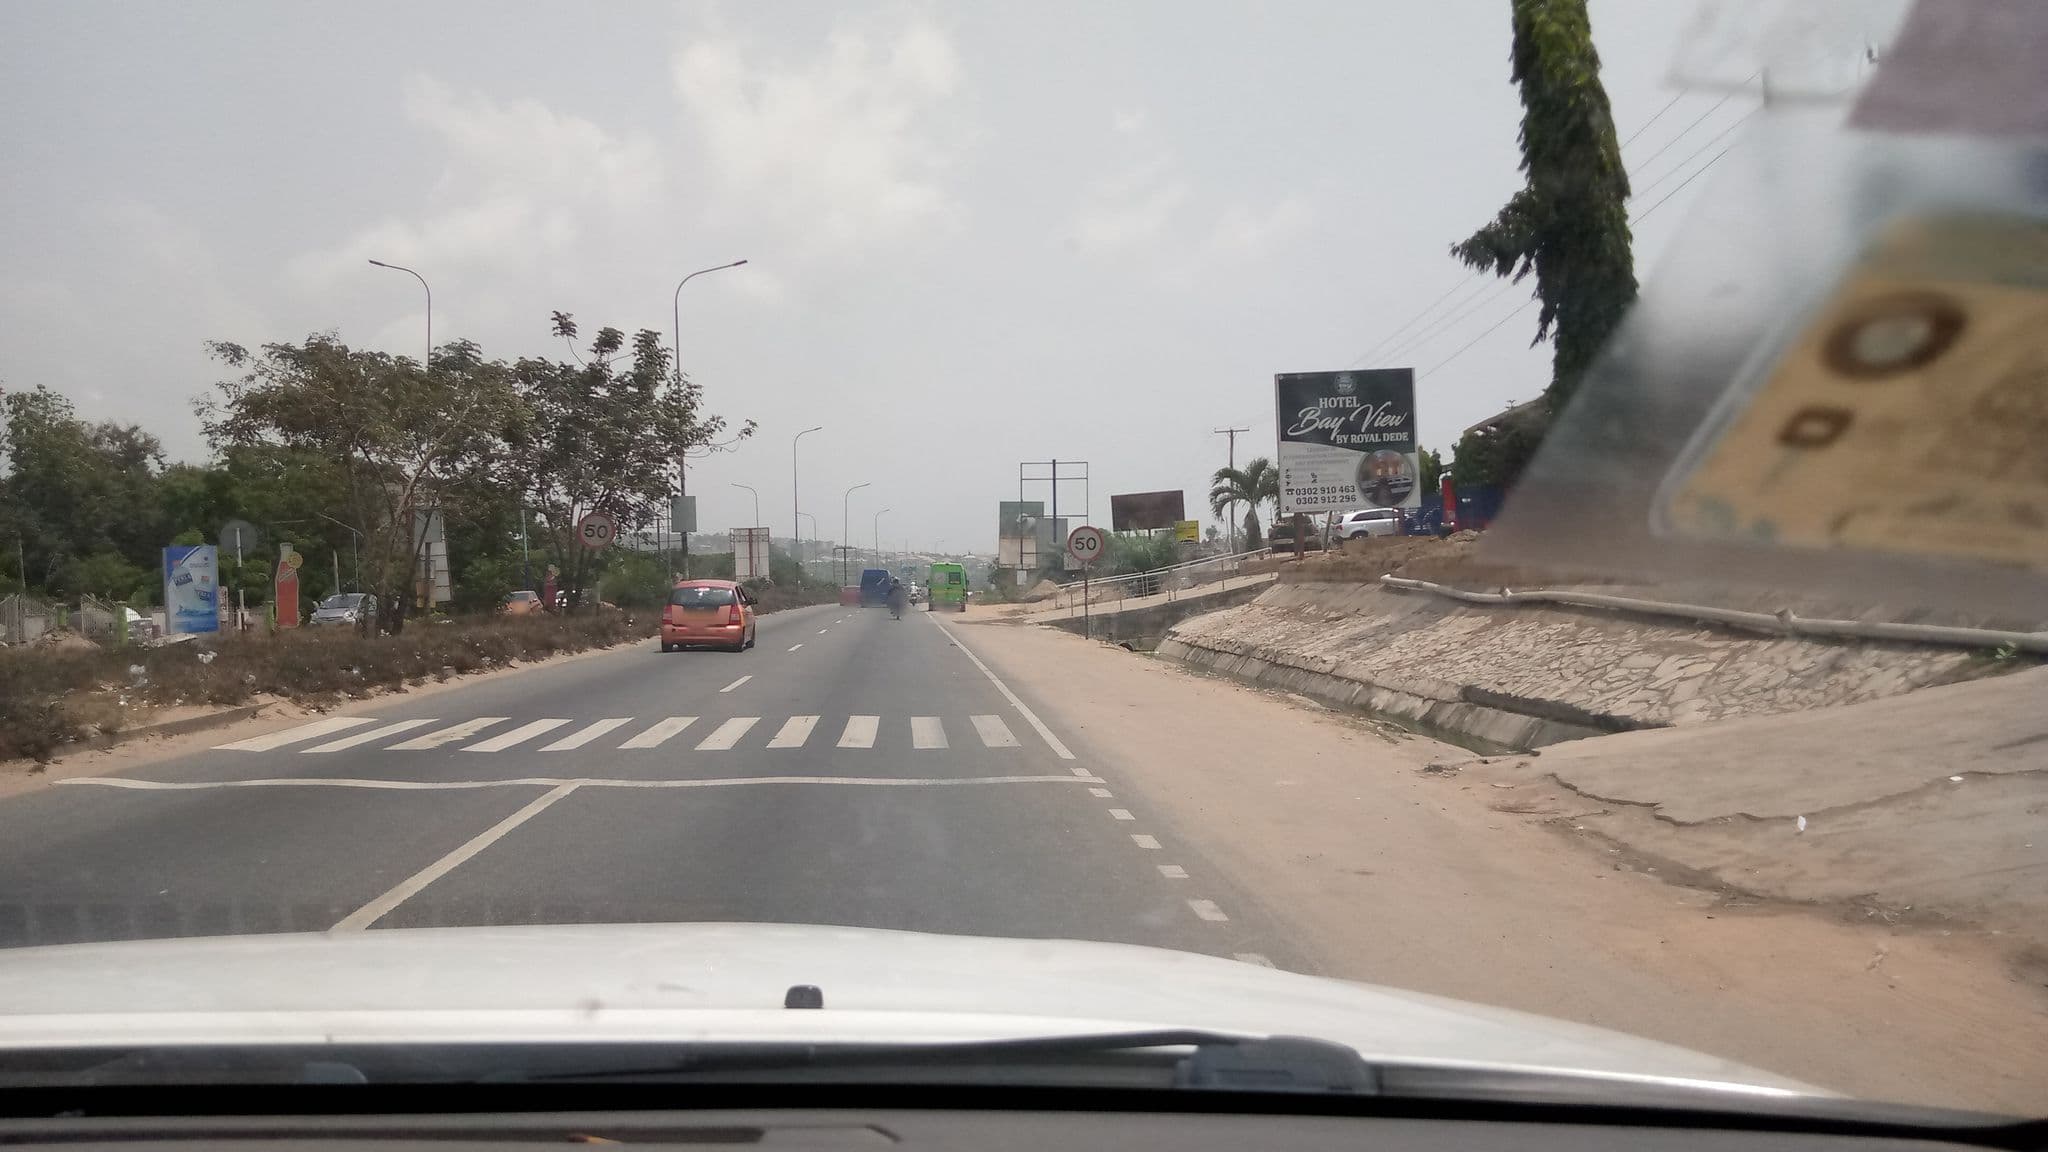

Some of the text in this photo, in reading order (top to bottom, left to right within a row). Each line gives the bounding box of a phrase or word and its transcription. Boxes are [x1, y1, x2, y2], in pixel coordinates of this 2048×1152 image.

[1319, 396, 1360, 409] HOTEL
[1287, 400, 1408, 441] Bay View
[1336, 432, 1409, 444] BY ROYAL DEDE
[1295, 485, 1356, 496] 0302 910 463
[1296, 494, 1357, 505] 0302 912 296
[585, 524, 608, 538] 50
[1075, 537, 1097, 550] 50
